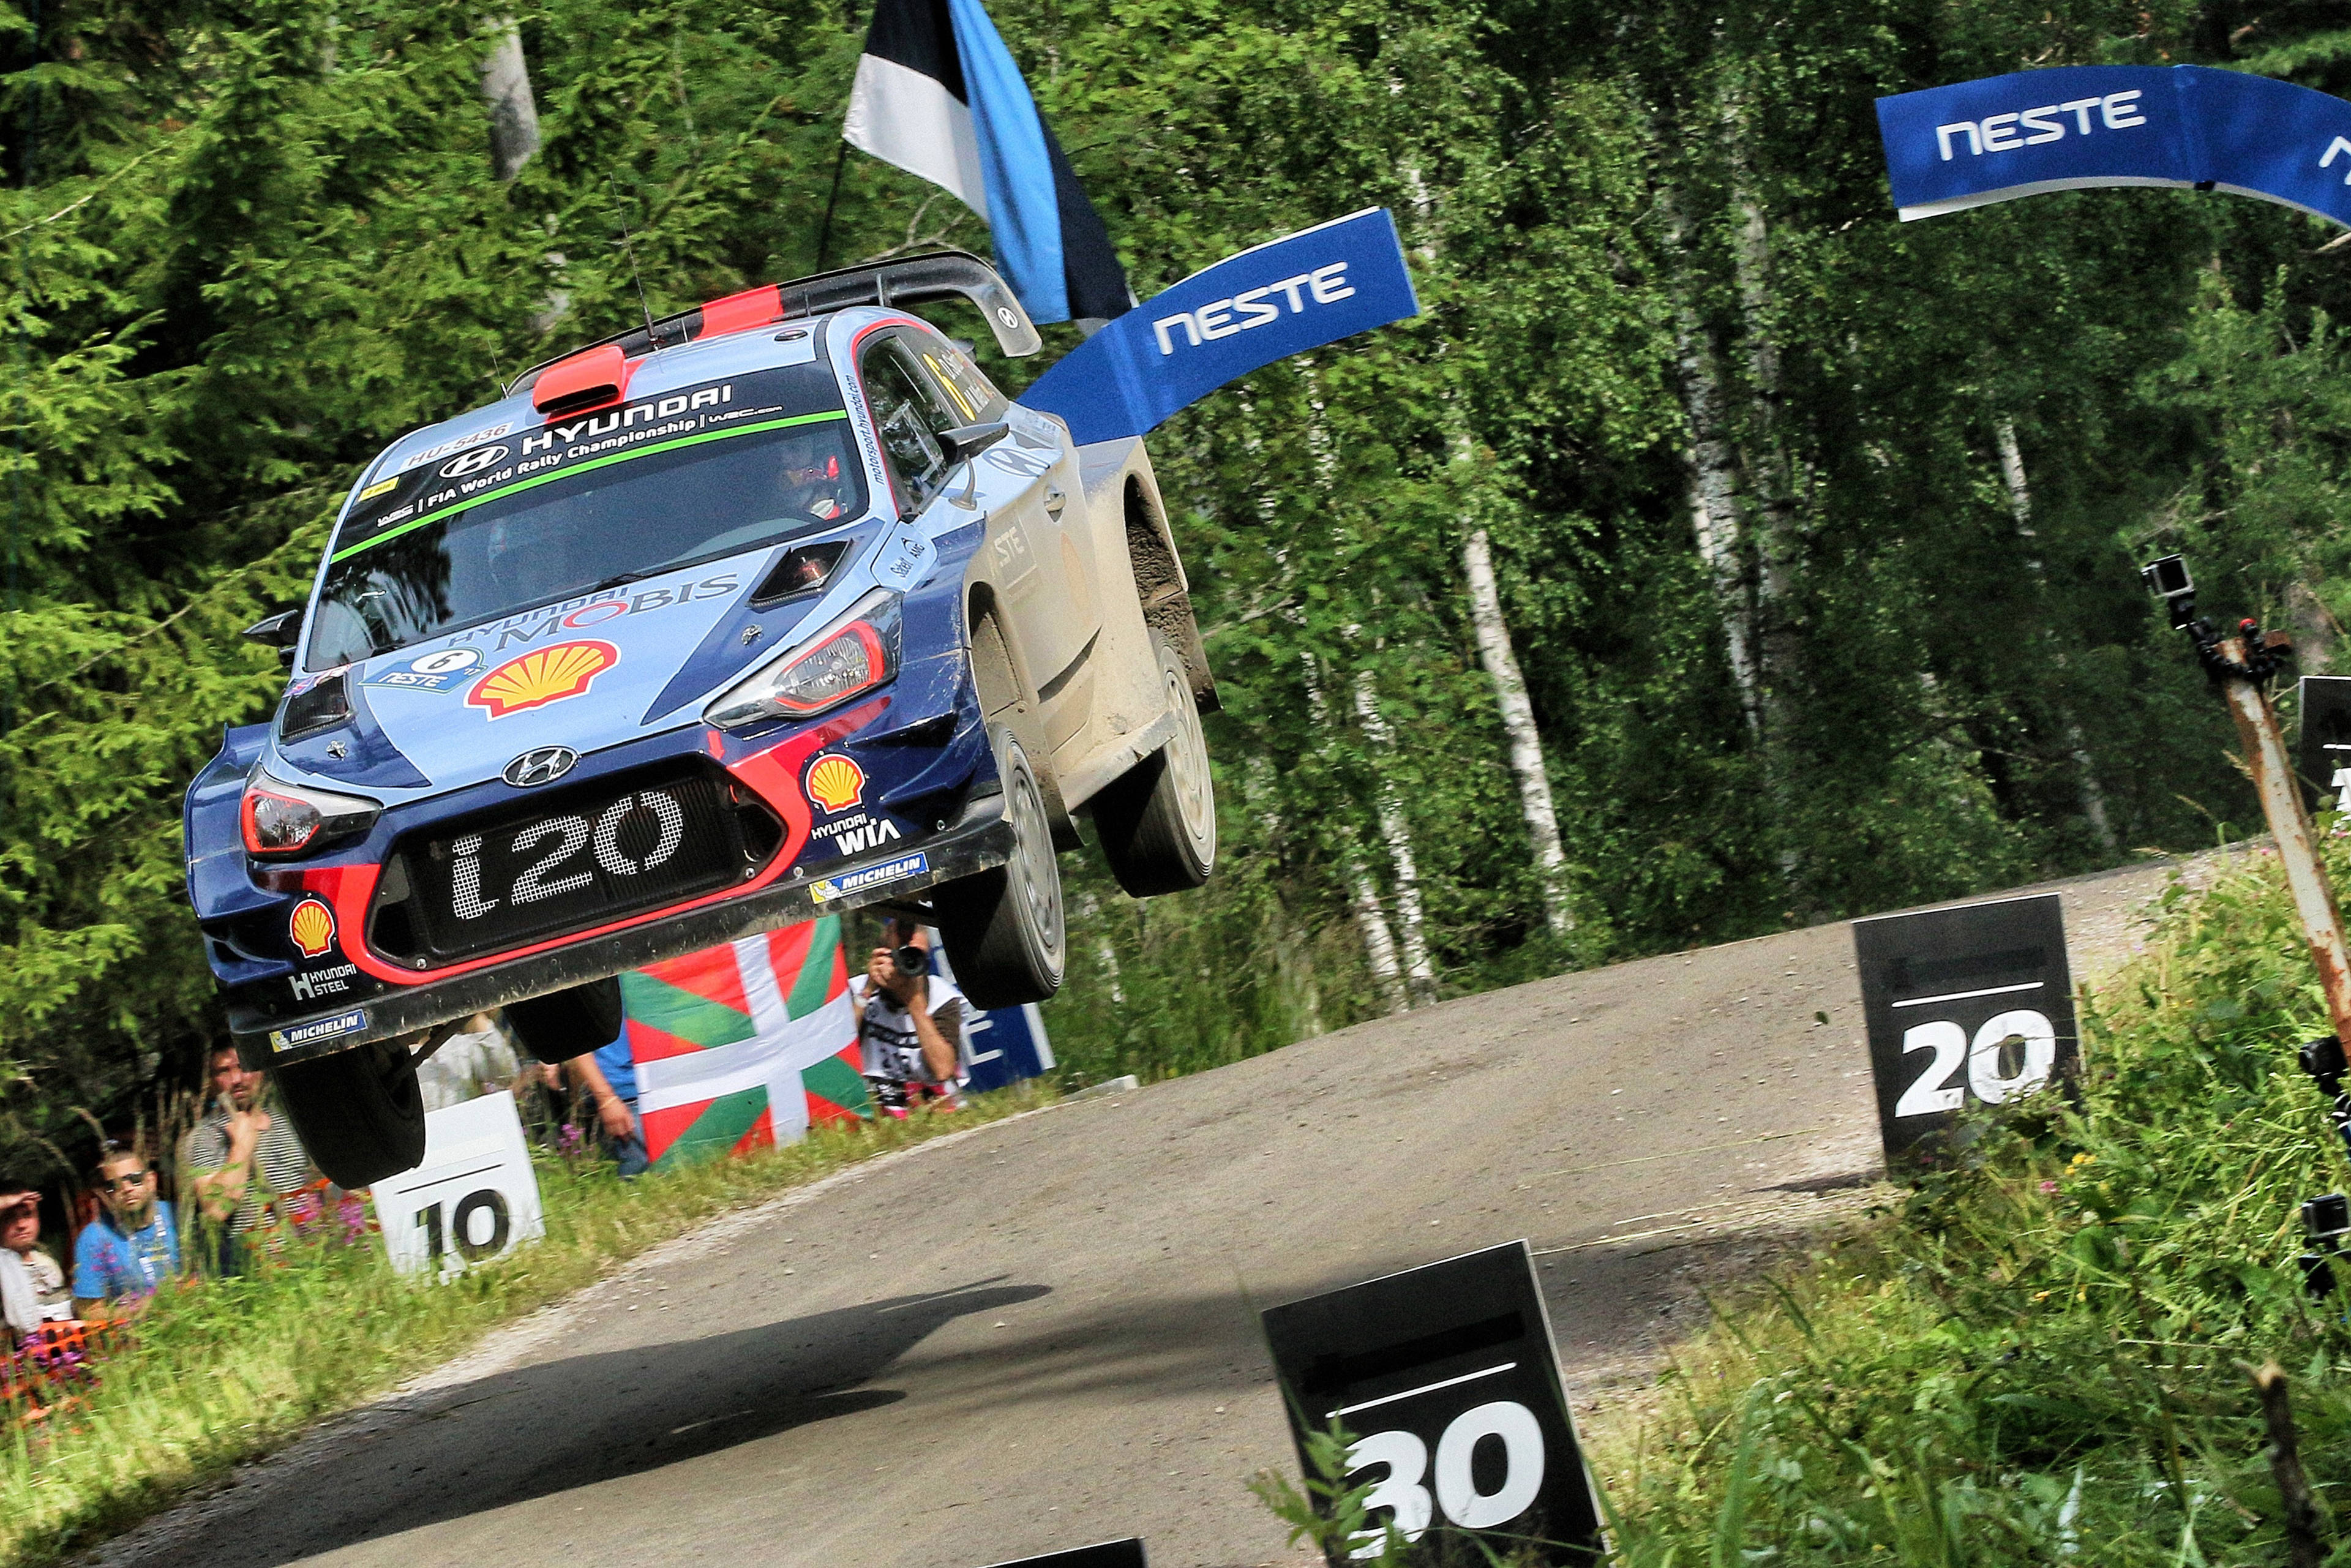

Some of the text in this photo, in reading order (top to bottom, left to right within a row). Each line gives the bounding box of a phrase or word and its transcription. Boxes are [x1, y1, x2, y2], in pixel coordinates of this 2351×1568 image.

[1935, 89, 2147, 162] NESTE
[1152, 260, 1356, 356] NESTE
[408, 424, 508, 467] HU-5436
[522, 383, 732, 456] HYUNDAI
[845, 374, 885, 486] motorsport.hyundai.com
[427, 488, 457, 508] FIA
[460, 467, 513, 493] World
[517, 452, 563, 475] Rally
[567, 419, 697, 459] Championship
[448, 587, 629, 648] HYUNDAI
[493, 573, 738, 652] MOBIS
[377, 672, 449, 687] NESTE
[427, 652, 463, 670] 6
[811, 812, 868, 841] HYUNDAI
[842, 857, 921, 890] MICHELIN
[309, 963, 358, 983] HYUNDAI
[313, 980, 350, 996] STEEL
[291, 1014, 359, 1042] MICHELIN
[1895, 1009, 2056, 1118] 20
[414, 1189, 511, 1269] 10
[1345, 1400, 1545, 1560] 30
